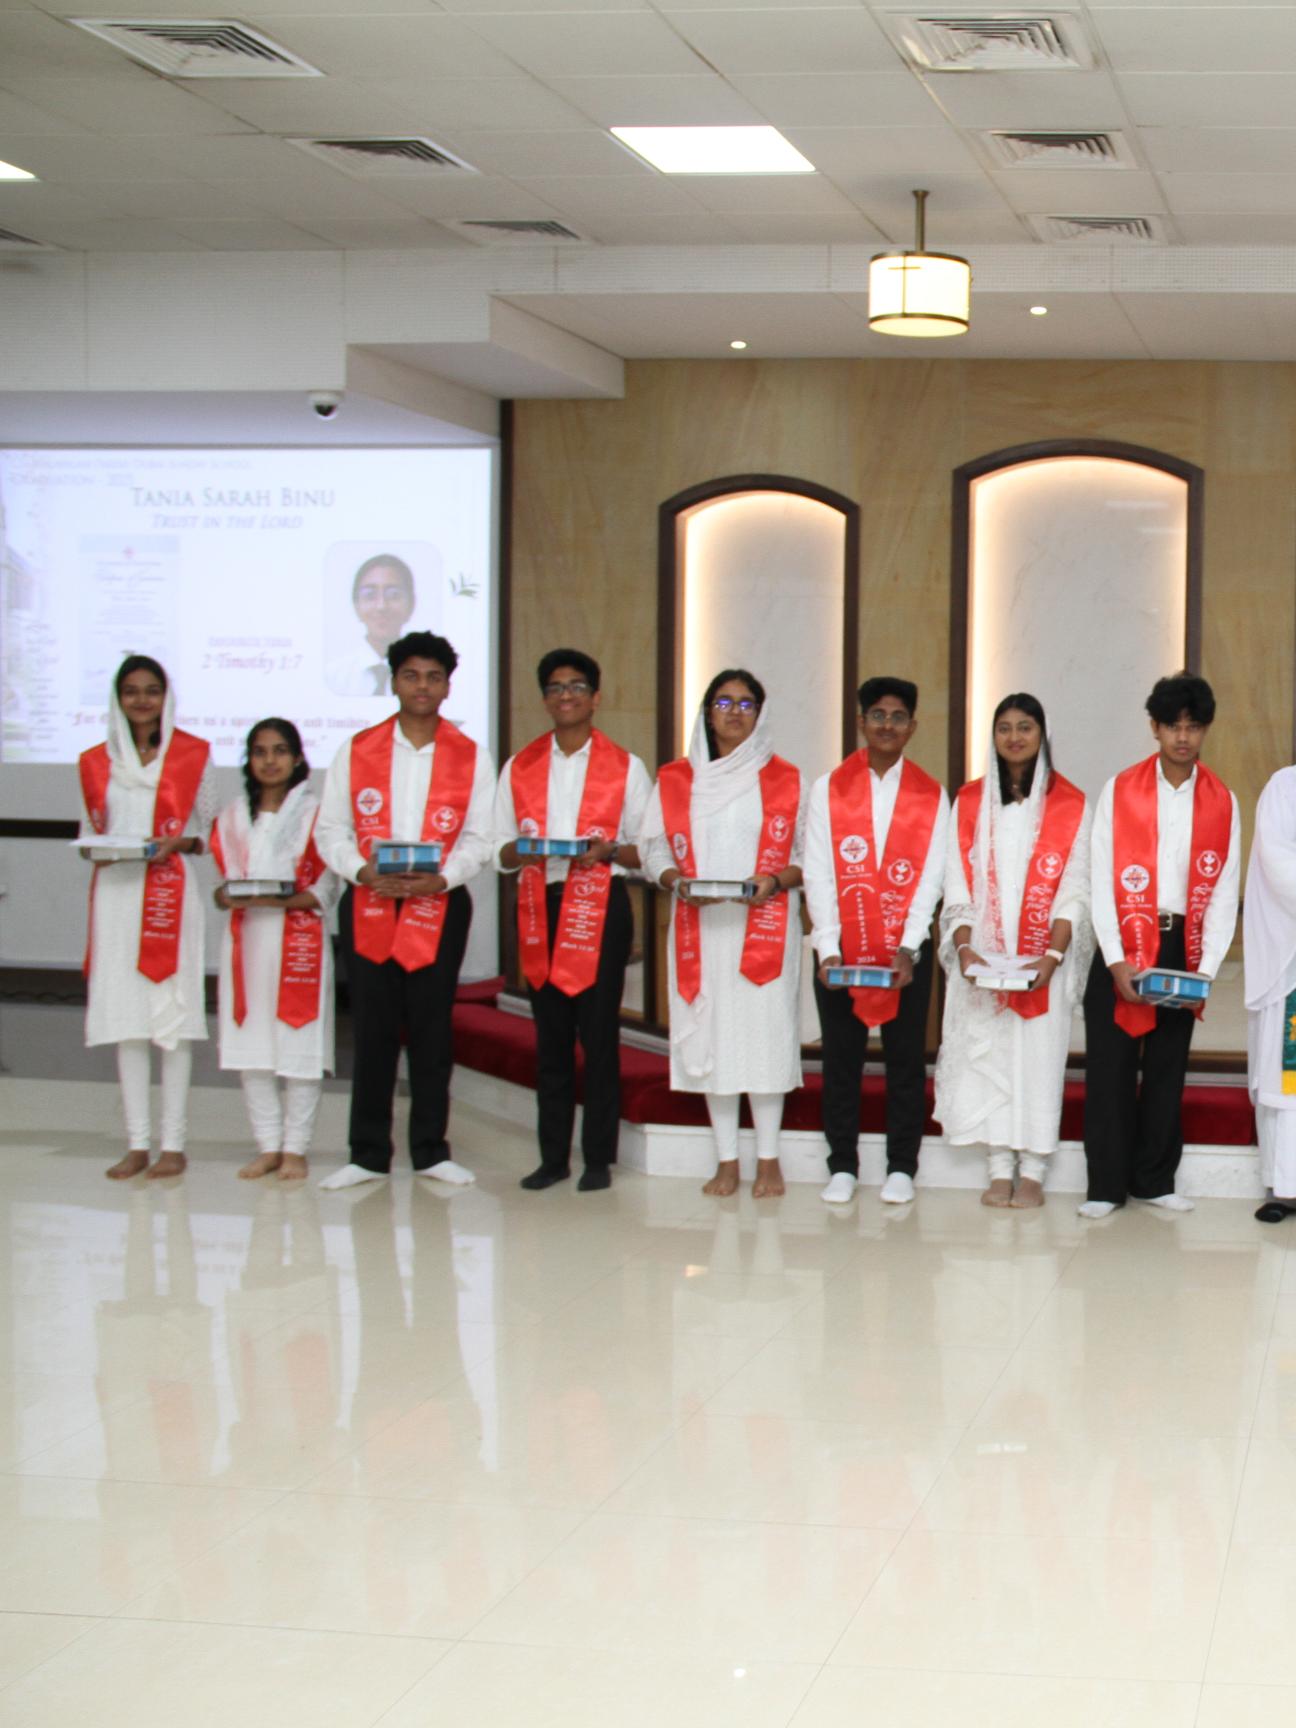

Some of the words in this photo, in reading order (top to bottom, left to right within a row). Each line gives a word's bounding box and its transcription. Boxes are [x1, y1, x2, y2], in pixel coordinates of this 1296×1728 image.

[131, 486, 195, 507] TANIA
[202, 486, 272, 507] SARAH
[280, 486, 336, 507] BINU
[846, 864, 865, 873] CSI
[1125, 894, 1145, 903] CSI
